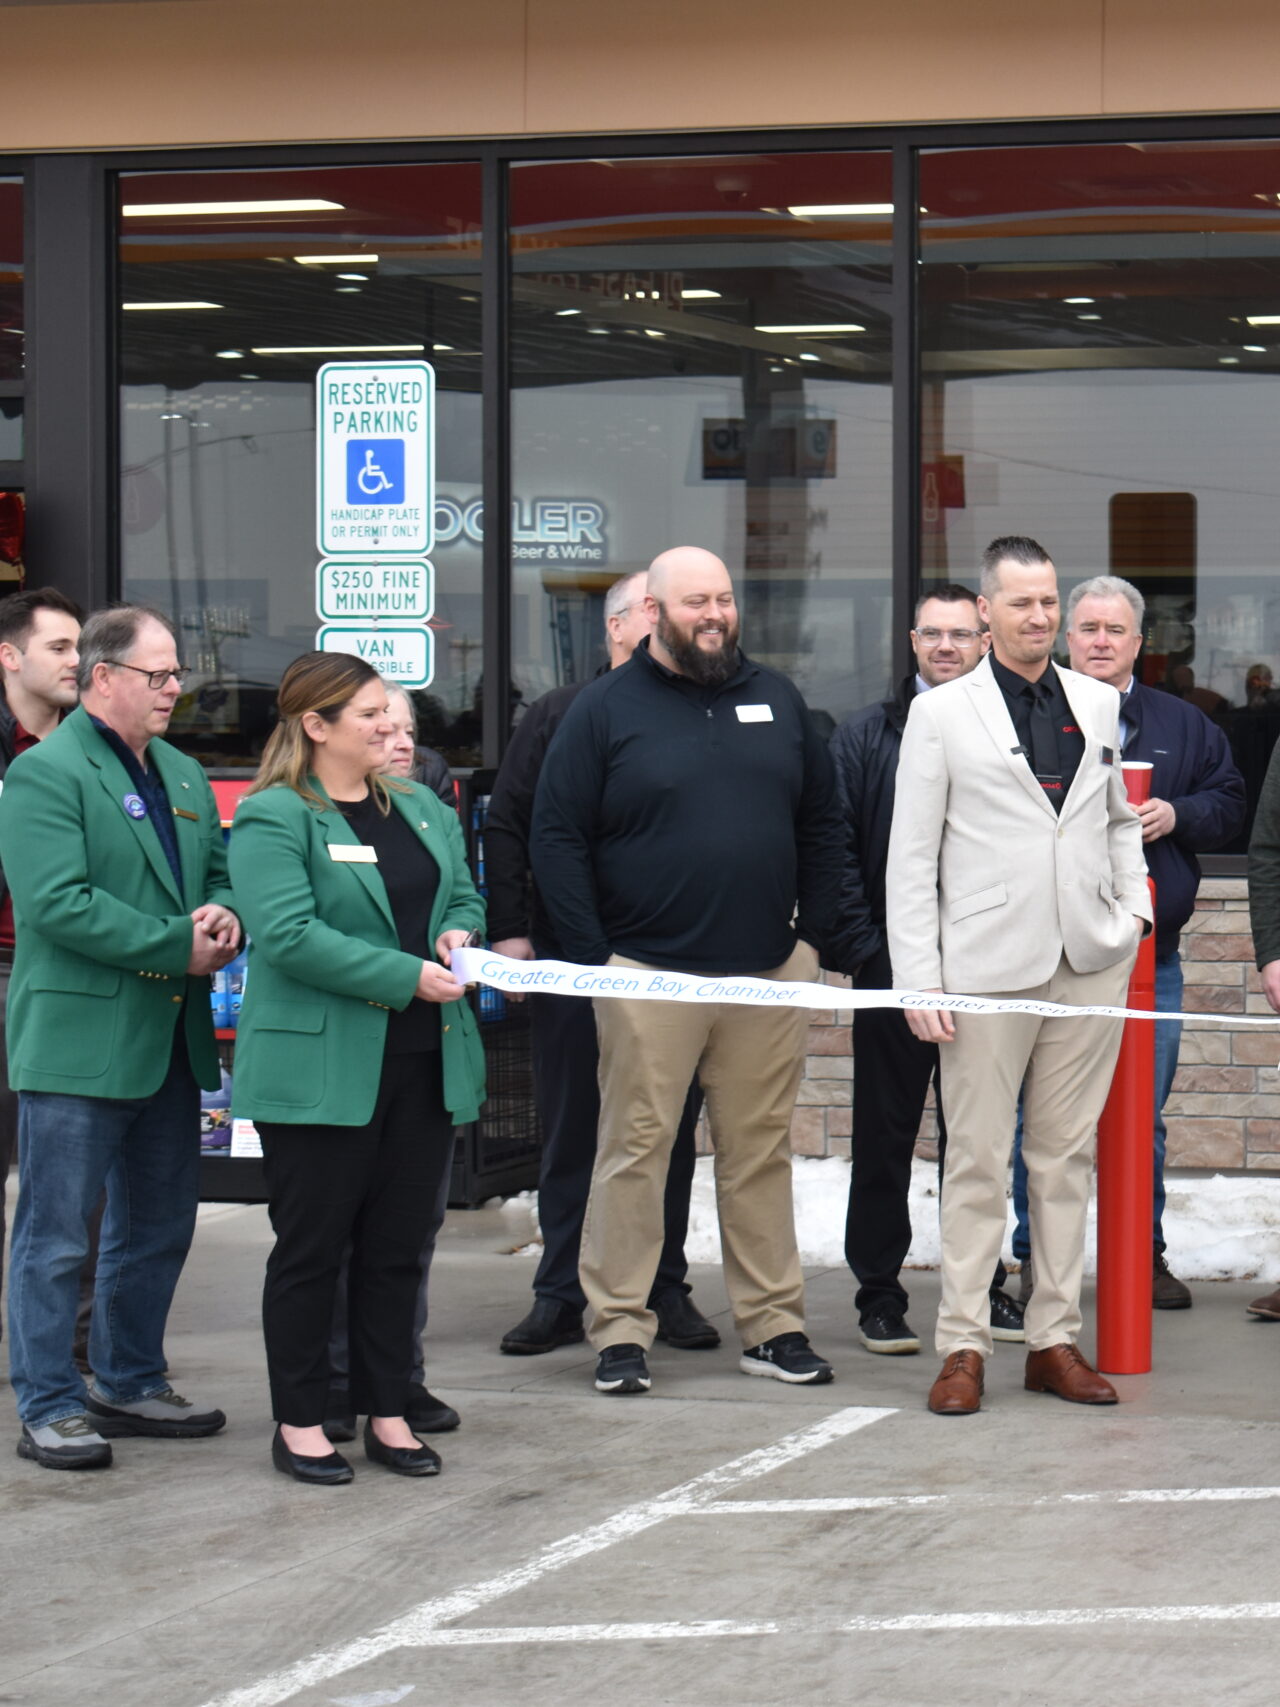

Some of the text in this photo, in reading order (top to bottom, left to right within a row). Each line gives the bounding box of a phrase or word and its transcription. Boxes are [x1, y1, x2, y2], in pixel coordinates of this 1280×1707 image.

[329, 382, 422, 405] RESERVED
[334, 411, 418, 433] PARKING
[331, 508, 420, 521] HANDICAP PLATE
[331, 525, 420, 538] OR PERMIT ONLY
[546, 545, 559, 559] &
[560, 546, 602, 559] Wine
[331, 570, 420, 588] $250 FINE
[336, 593, 416, 610] MINIMUM
[357, 639, 394, 657] VAN
[371, 661, 414, 673] SSIBLE
[481, 961, 801, 1000] Greater Green Bay Chamber
[899, 994, 989, 1010] Greater
[997, 1002, 1067, 1015] Green
